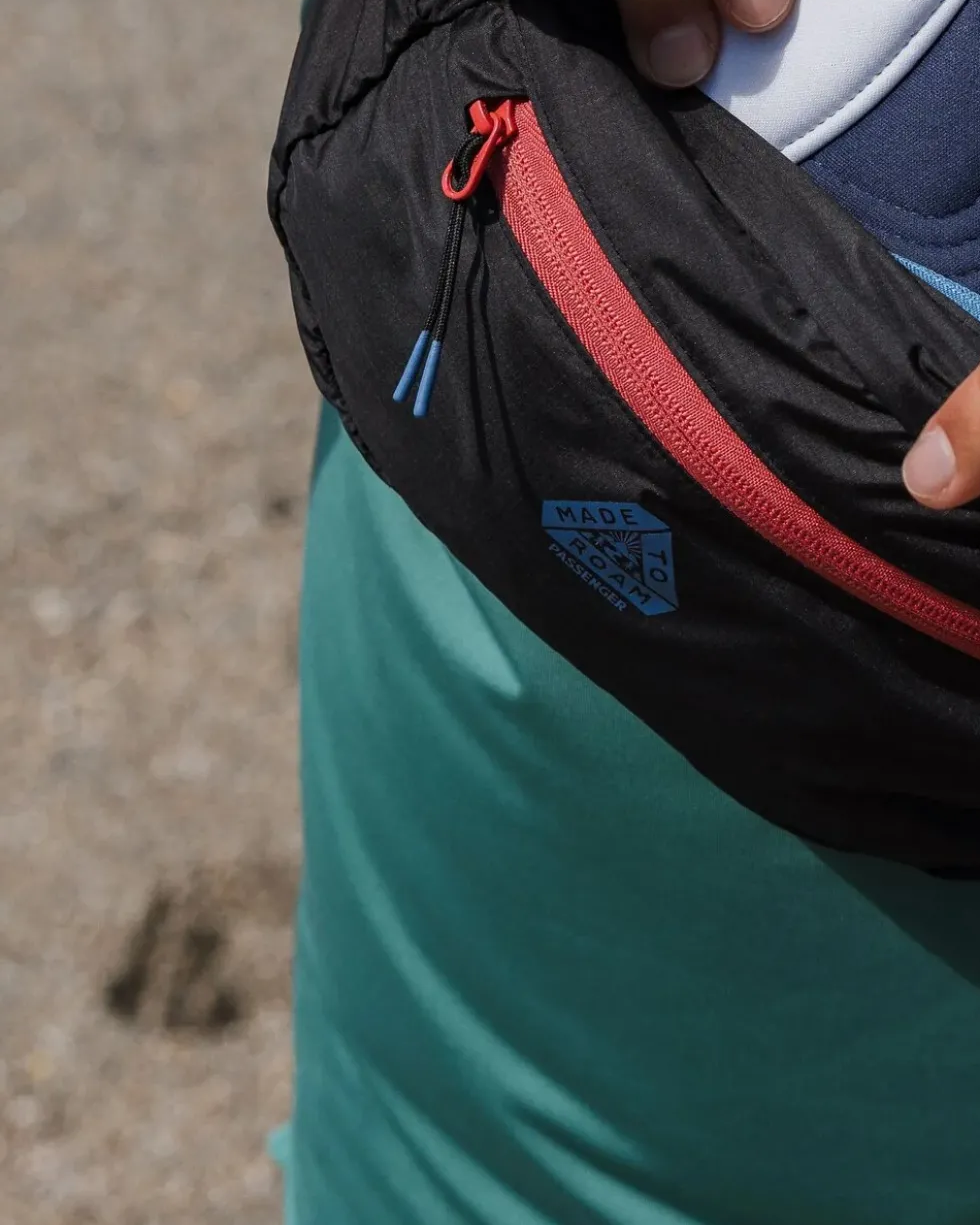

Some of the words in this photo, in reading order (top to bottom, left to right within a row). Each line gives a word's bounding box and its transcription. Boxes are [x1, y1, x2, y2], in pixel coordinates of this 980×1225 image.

[555, 506, 638, 525] MADE
[548, 543, 628, 612] PASSENGER
[569, 537, 652, 605] ROAM
[648, 550, 668, 583] TO
